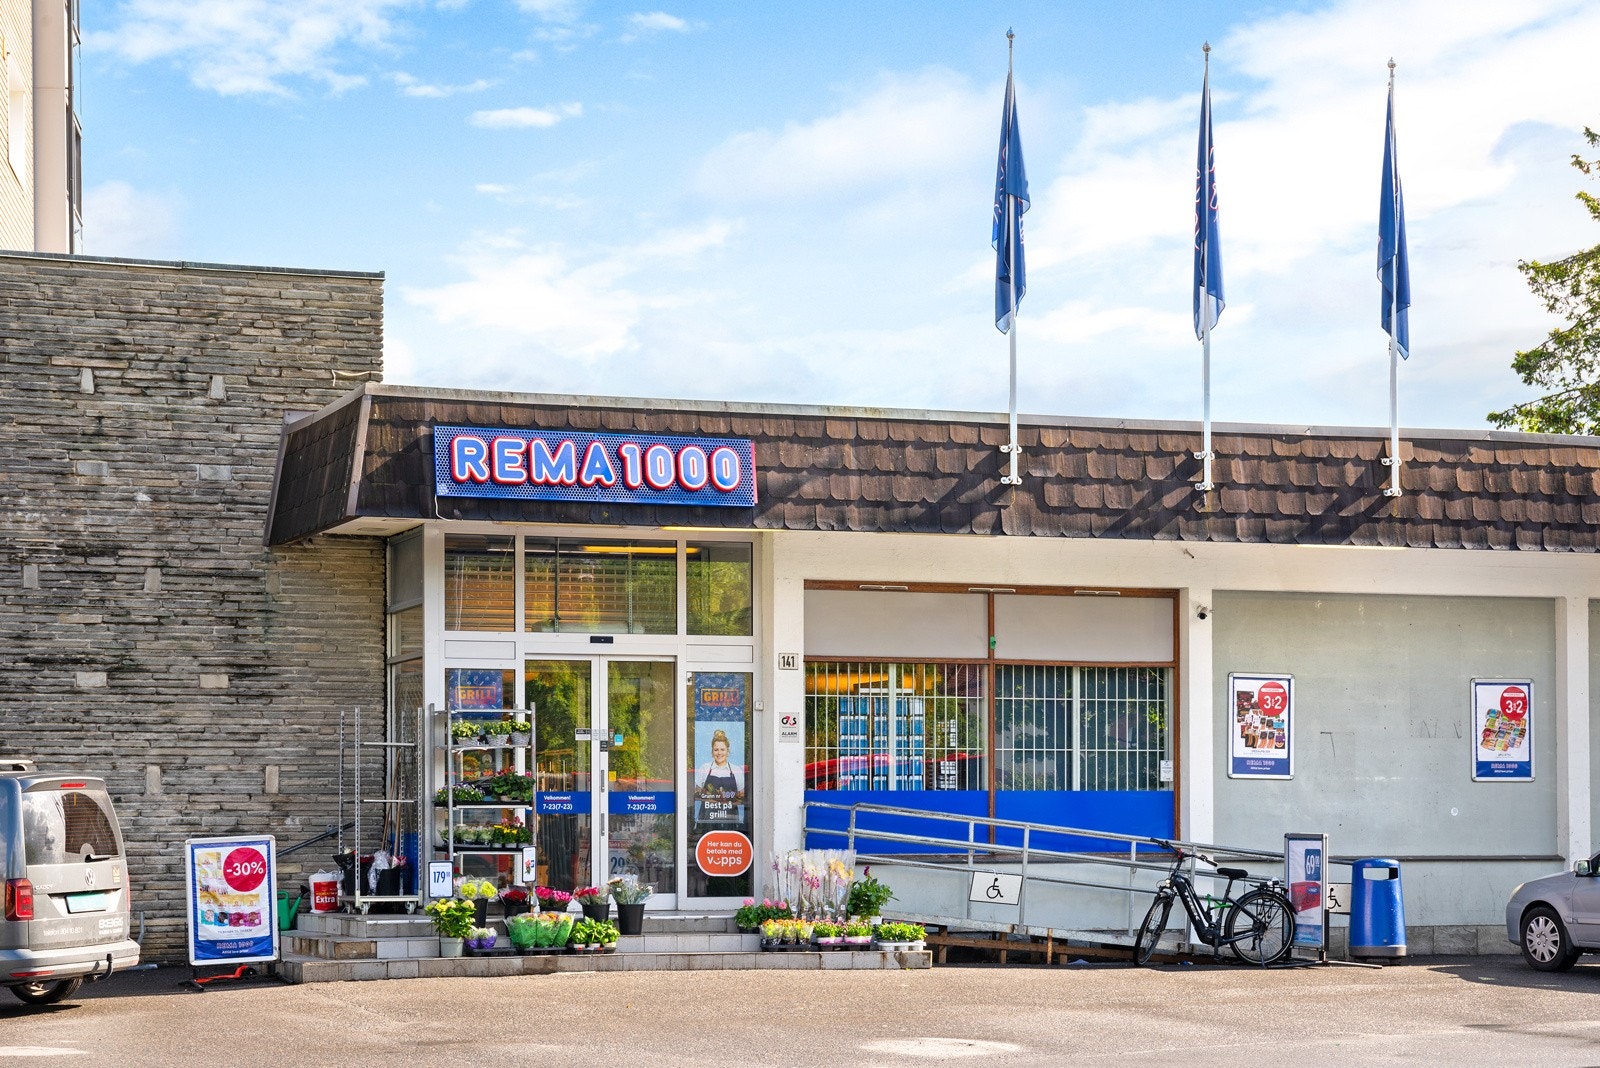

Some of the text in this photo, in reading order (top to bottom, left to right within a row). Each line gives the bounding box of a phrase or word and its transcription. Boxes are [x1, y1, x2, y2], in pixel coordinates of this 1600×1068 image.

[781, 655, 795, 668] 141
[459, 689, 492, 700] GRILL
[703, 691, 736, 702] GRILL
[1263, 696, 1272, 709] 3
[1274, 696, 1282, 709] 2
[1506, 700, 1513, 714] 3
[1516, 701, 1523, 714] 2
[723, 800, 733, 811] på
[709, 810, 727, 820] grill!
[226, 861, 264, 876] -30%
[610, 856, 625, 874] 29
[1306, 855, 1315, 874] 69
[433, 871, 446, 884] 179
